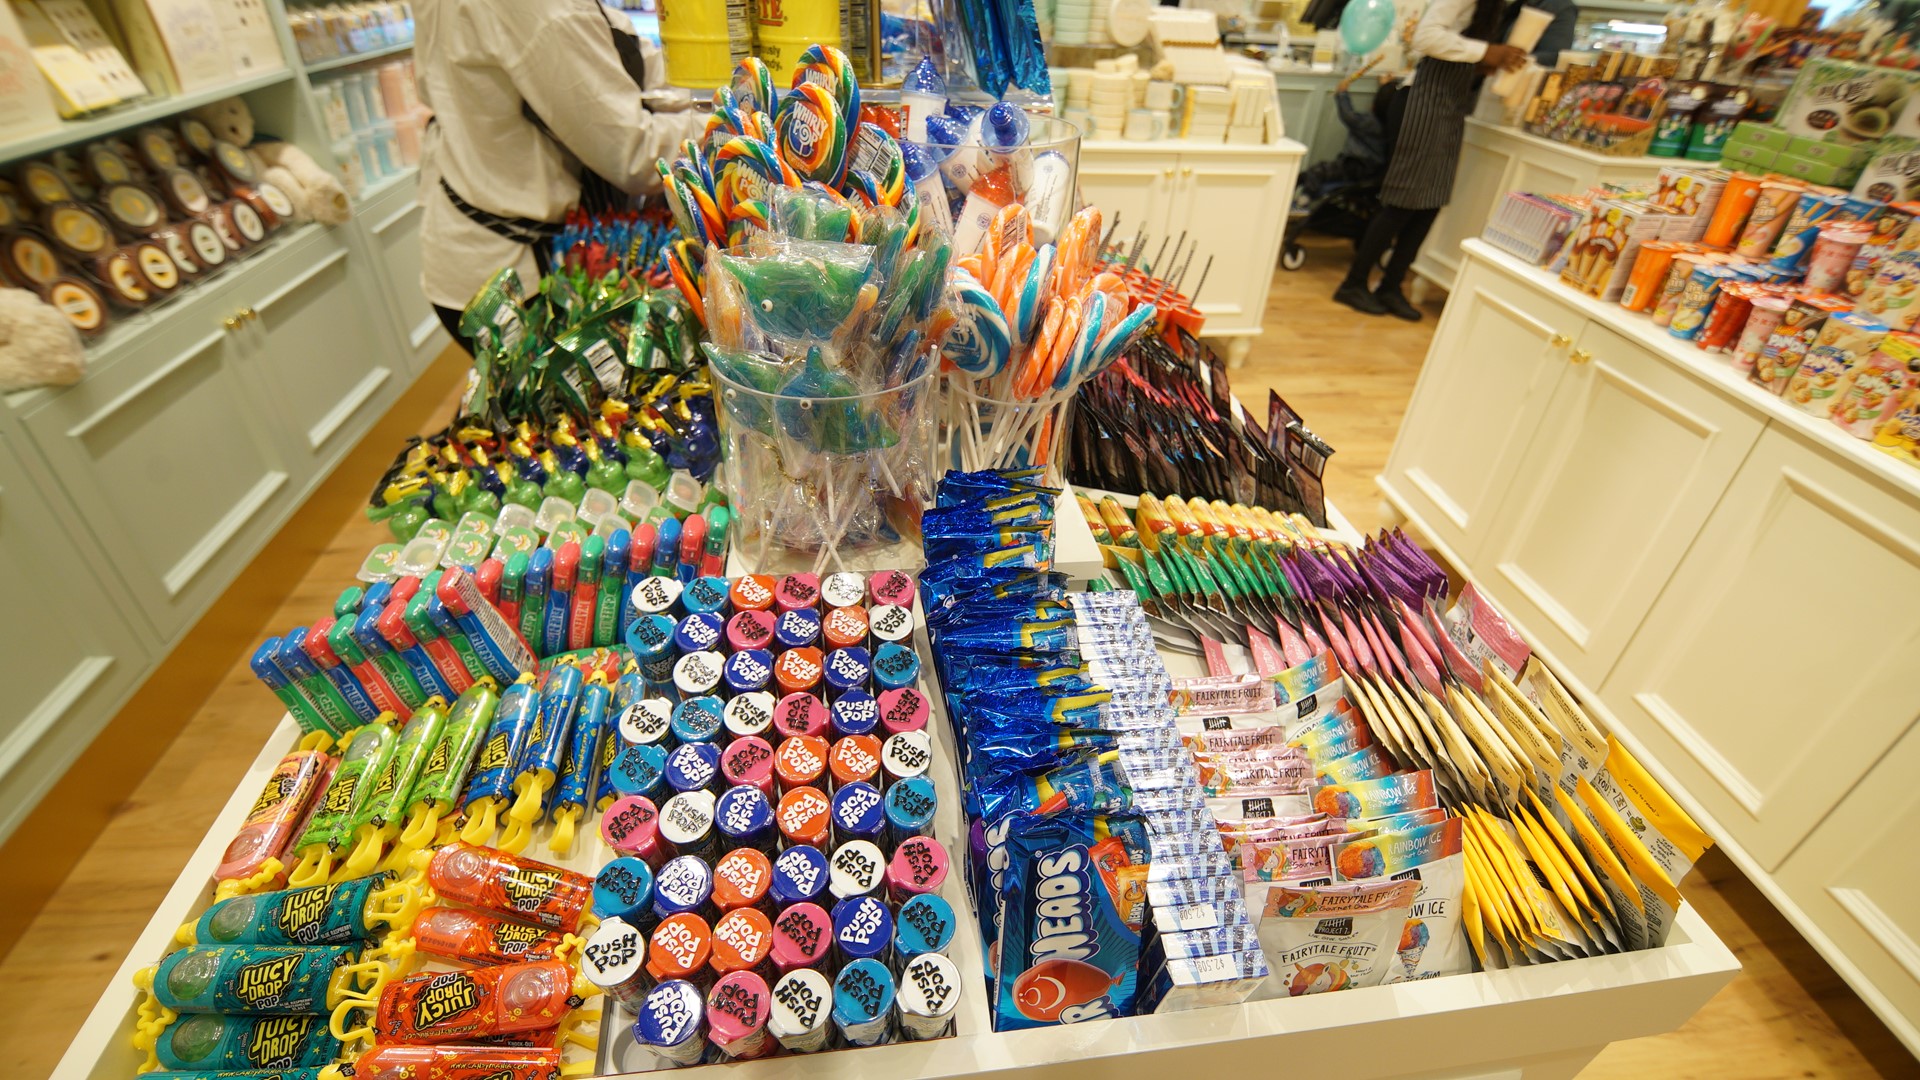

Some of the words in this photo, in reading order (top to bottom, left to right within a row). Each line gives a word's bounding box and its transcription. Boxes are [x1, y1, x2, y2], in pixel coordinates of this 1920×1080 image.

[793, 101, 829, 140] WHIRLY
[641, 585, 658, 606] POP
[650, 577, 669, 605] PUSH
[736, 583, 761, 602] POP
[741, 575, 772, 600] PUSH
[785, 576, 817, 597] PUSH
[687, 614, 718, 640] PUSH
[741, 611, 770, 637] PUSH
[782, 620, 810, 638] POP
[785, 611, 819, 633] PUSH
[830, 619, 857, 637] POP
[832, 610, 867, 632] PUSH
[873, 605, 902, 631] PUSH
[884, 612, 907, 634] POP
[681, 623, 707, 644] POP
[731, 660, 759, 682] POP
[737, 651, 770, 678] PUSH
[782, 660, 811, 680] POP
[785, 650, 820, 676] PUSH
[830, 659, 859, 680] POP
[835, 649, 868, 676] PUSH
[835, 700, 876, 713] PUSH
[1196, 690, 1236, 701] FAIRYTALE
[1238, 688, 1261, 698] FRUIT
[631, 704, 667, 730] PUSH
[732, 706, 759, 727] POP
[736, 695, 770, 722] PUSH
[840, 710, 874, 723] POP
[627, 714, 656, 734] POP
[789, 736, 822, 771] PUSH
[842, 737, 878, 770] PUSH
[893, 735, 930, 762] PUSH
[1209, 737, 1250, 747] FAIRYTALE
[1251, 735, 1273, 745] FRUIT
[673, 755, 700, 781] POP
[679, 743, 714, 778] PUSH
[782, 747, 811, 774] POP
[837, 749, 867, 774] POP
[890, 747, 920, 768] POP
[1280, 767, 1303, 778] FRUIT
[725, 792, 748, 826] POP
[783, 793, 818, 821] POP
[839, 788, 868, 817] POP
[843, 791, 881, 828] PUSH
[894, 795, 925, 817] POP
[897, 783, 935, 810] PUSH
[667, 809, 699, 833] POP
[672, 797, 711, 829] PUSH
[734, 789, 760, 832] PUSH
[785, 799, 828, 833] PUSH
[1388, 837, 1427, 854] RAINBOW
[1428, 831, 1441, 844] ICE
[730, 856, 762, 884] POP
[789, 851, 820, 882] POP
[834, 854, 872, 888] PUSH
[844, 849, 876, 875] POP
[902, 843, 929, 888] PUSH
[916, 841, 939, 877] POP
[506, 871, 561, 889] JUICY
[596, 872, 638, 905] PUSH
[610, 866, 642, 890] POP
[657, 872, 700, 905] PUSH
[670, 860, 704, 890] POP
[717, 860, 757, 899] PUSH
[776, 856, 814, 896] PUSH
[280, 883, 340, 923] JUICY
[515, 883, 547, 897] DROP
[1321, 893, 1374, 905] FAIRYTALE
[290, 902, 324, 932] DROP
[518, 899, 539, 911] POP
[916, 901, 947, 934] POP
[1428, 901, 1445, 914] ICE
[298, 923, 318, 943] POP
[729, 916, 763, 947] POP
[790, 912, 822, 942] POP
[840, 897, 877, 944] PUSH
[855, 908, 883, 945] POP
[902, 906, 940, 949] PUSH
[504, 930, 537, 942] DROP
[504, 943, 527, 954] POP
[585, 933, 637, 962] PUSH
[653, 927, 696, 969] PUSH
[667, 921, 701, 953] POP
[715, 923, 758, 963] PUSH
[777, 916, 817, 957] PUSH
[594, 949, 636, 974] POP
[1282, 945, 1337, 963] FAIRYTALE
[239, 957, 301, 994] JUICY
[432, 973, 457, 987] POP
[851, 967, 885, 1000] POP
[910, 963, 943, 1015] PUSH
[924, 960, 952, 1000] POP
[249, 981, 282, 1000] DROP
[257, 996, 278, 1009] POP
[426, 982, 463, 1003] DROP
[721, 983, 760, 1010] POP
[789, 978, 822, 1012] POP
[838, 973, 880, 1017] PUSH
[419, 988, 474, 1026] JUICY
[647, 990, 680, 1045] PUSH
[662, 986, 692, 1028] POP
[710, 992, 757, 1028] PUSH
[775, 984, 816, 1030] PUSH
[251, 1016, 313, 1056] JUICY
[262, 1036, 298, 1069] DROP
